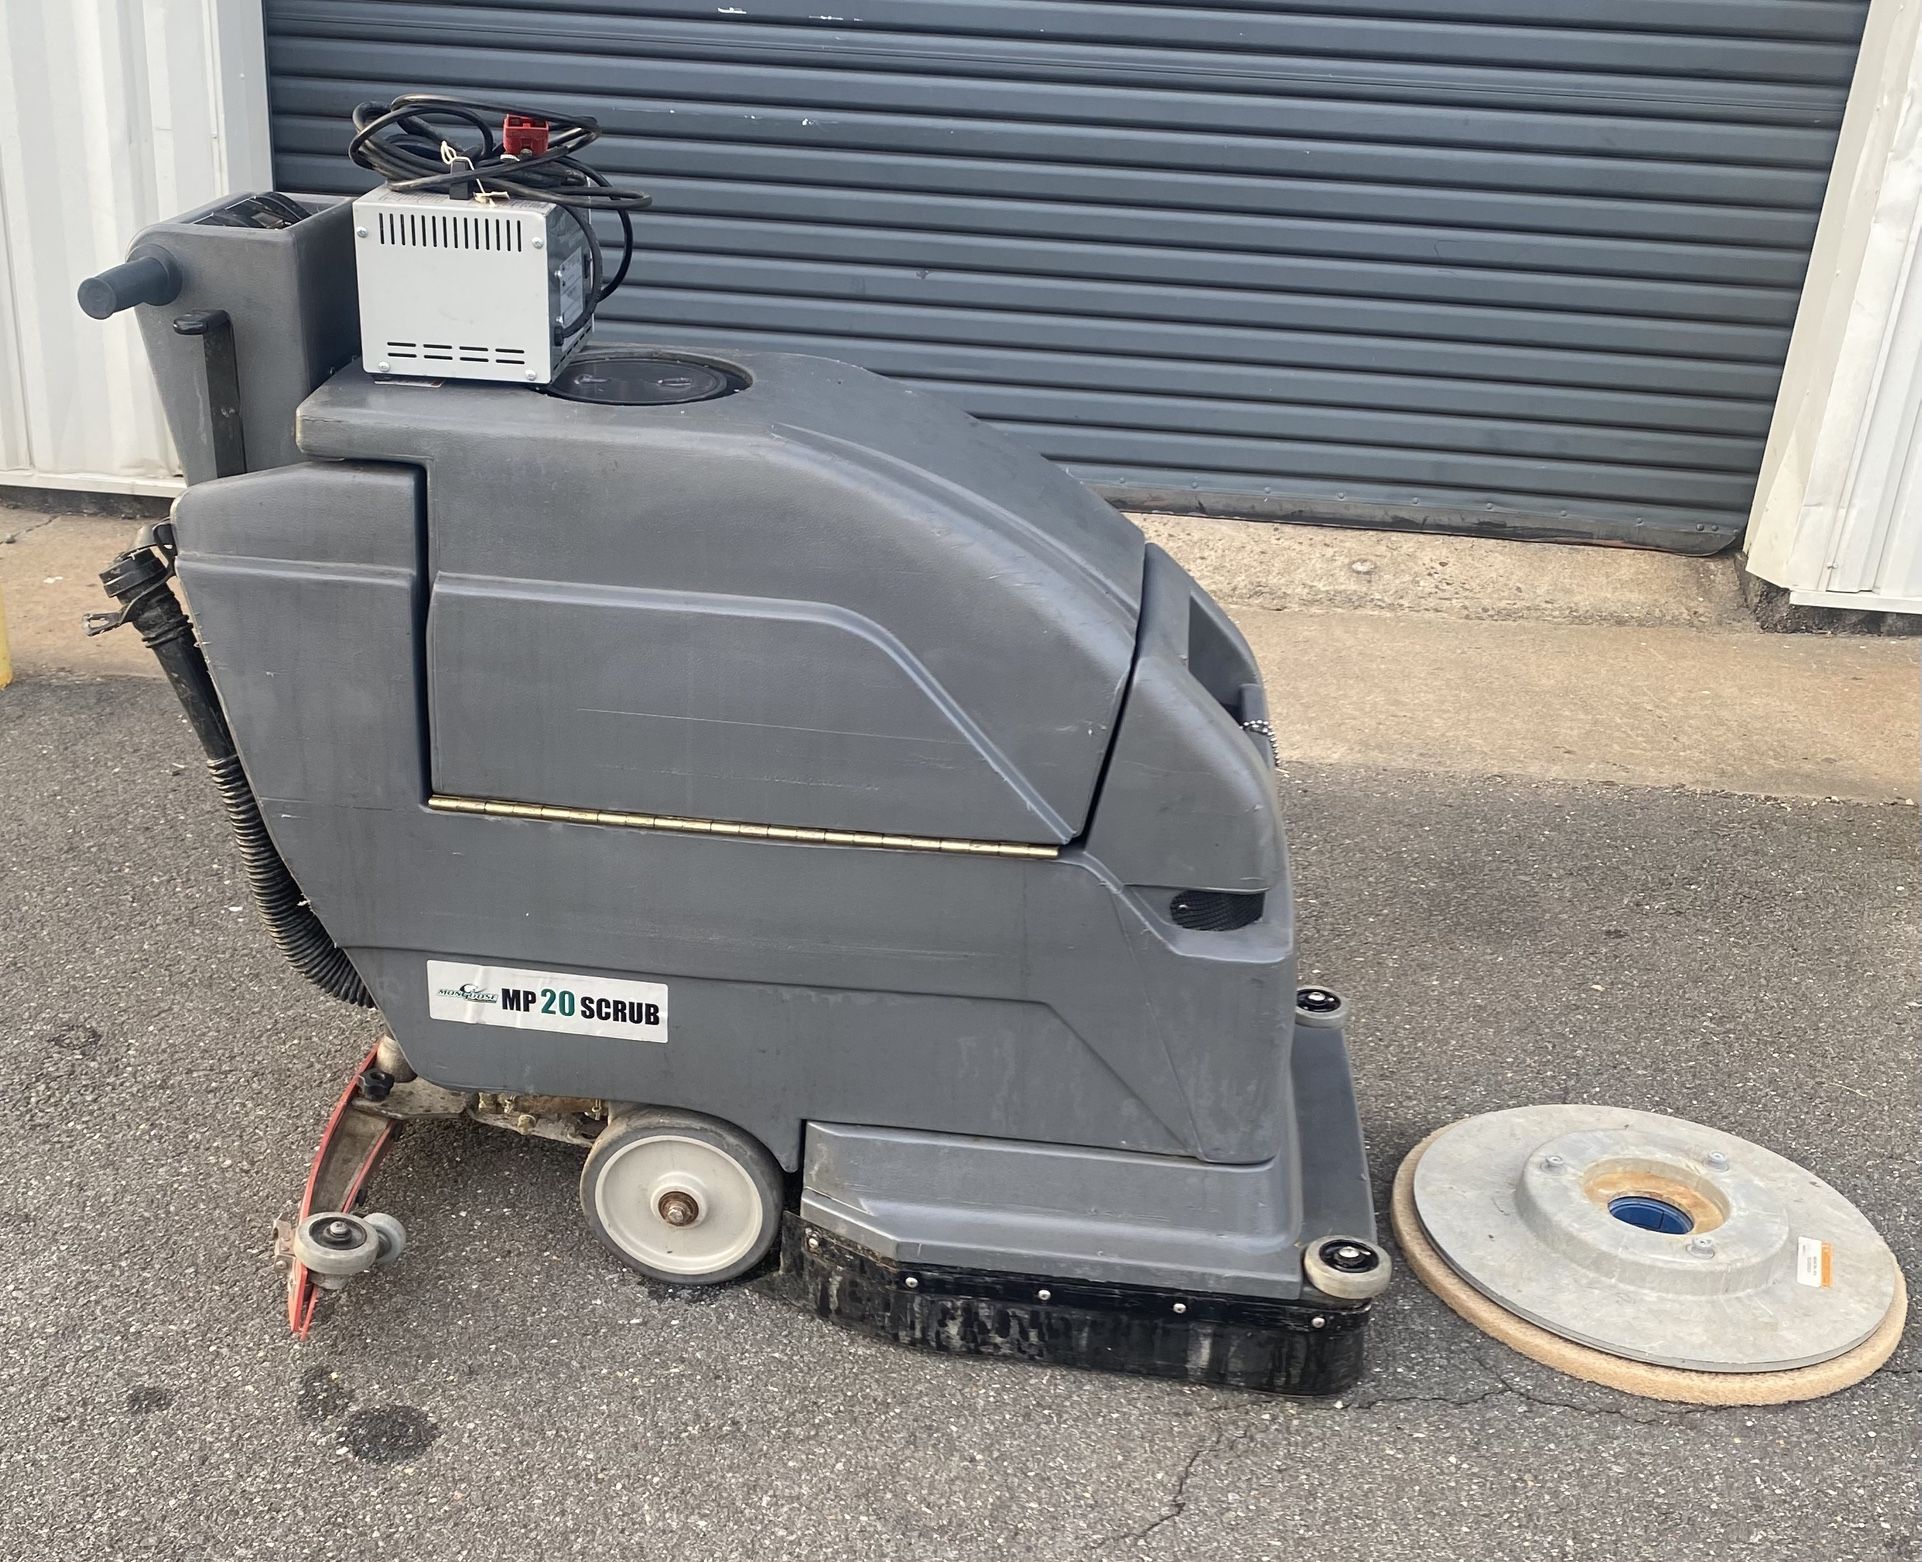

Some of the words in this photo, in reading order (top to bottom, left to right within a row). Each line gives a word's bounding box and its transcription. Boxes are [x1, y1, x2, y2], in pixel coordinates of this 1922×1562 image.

[438, 986, 498, 1002] MONGOOSE
[501, 988, 536, 1012] MP
[541, 988, 575, 1017] 20
[580, 996, 660, 1026] SCRUB
